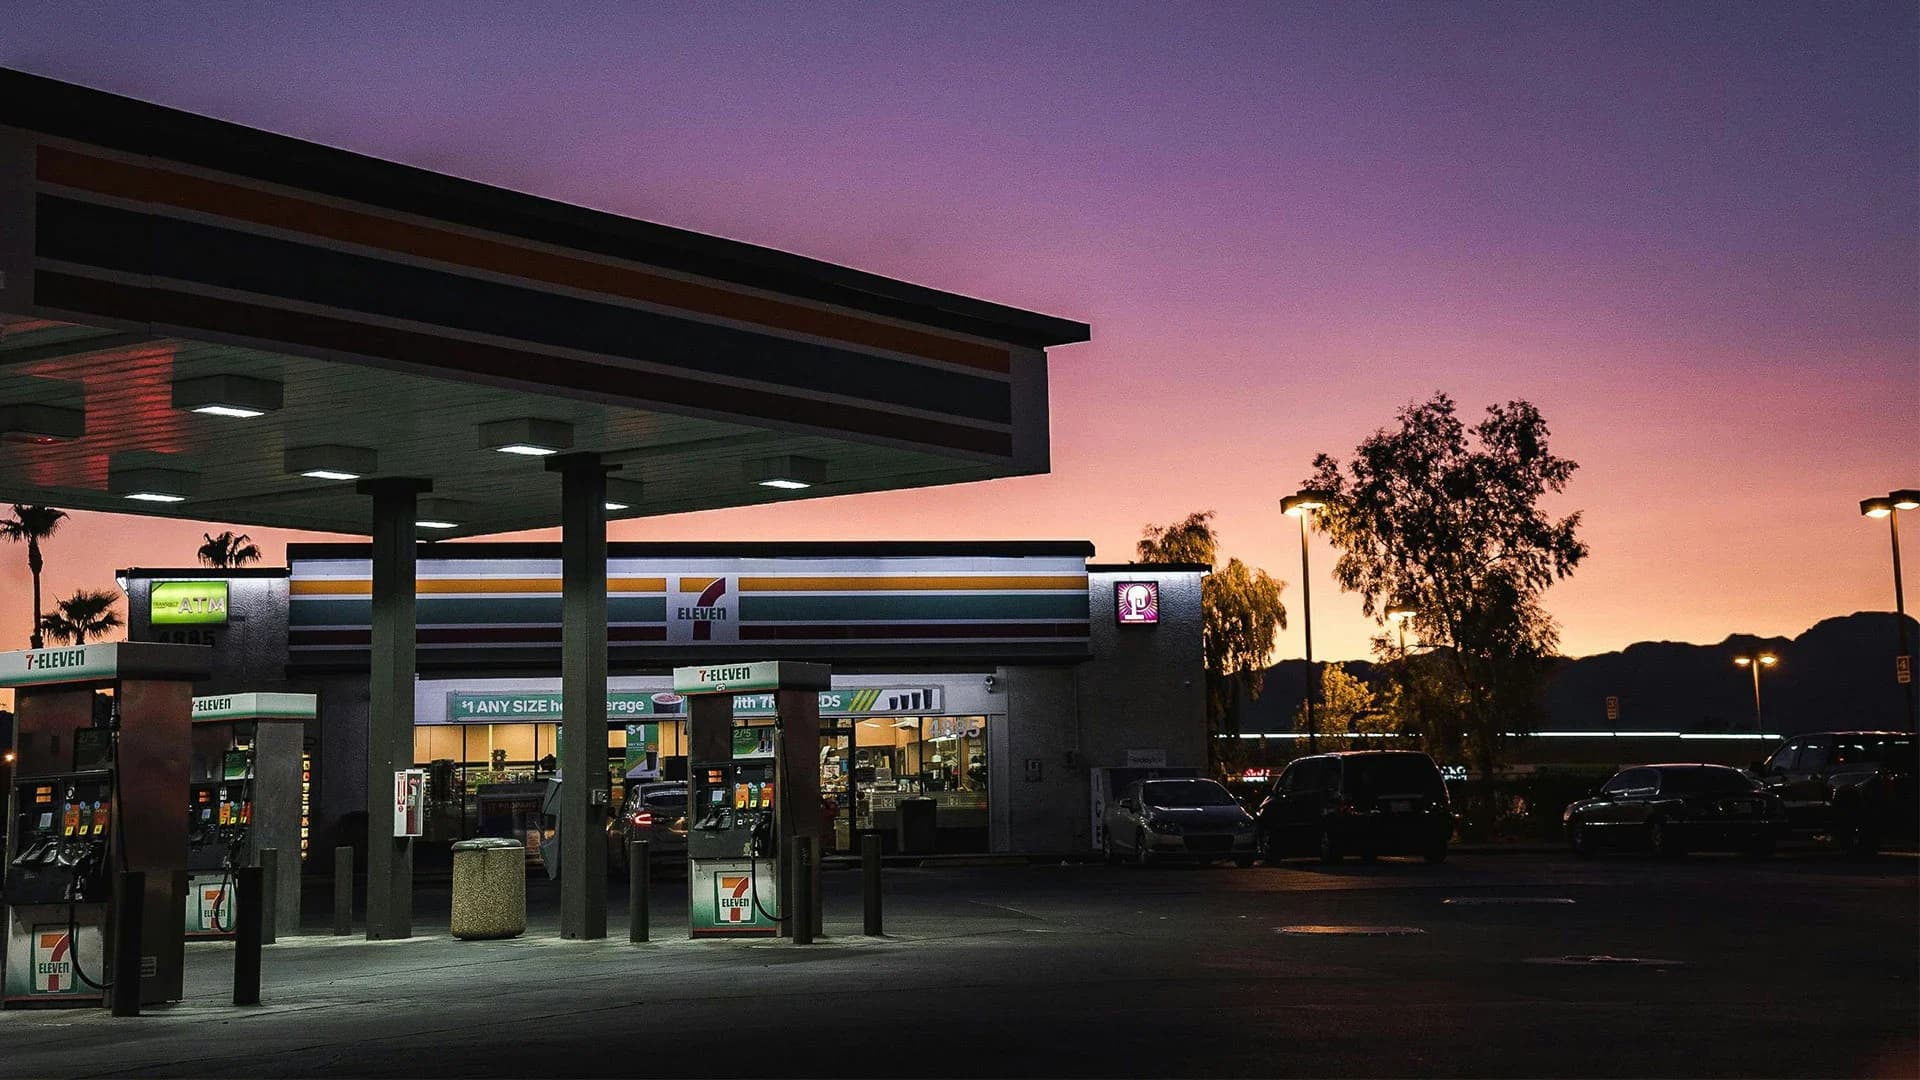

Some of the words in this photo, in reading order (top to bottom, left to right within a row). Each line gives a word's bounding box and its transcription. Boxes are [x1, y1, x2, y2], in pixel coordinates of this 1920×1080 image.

[178, 597, 225, 614] ATM
[680, 577, 726, 640] 7
[461, 700, 474, 713] $1
[476, 700, 510, 713] ANY
[512, 700, 548, 713] SIZE
[627, 724, 645, 742] $1
[722, 877, 749, 921] 7
[40, 934, 70, 991] 7
